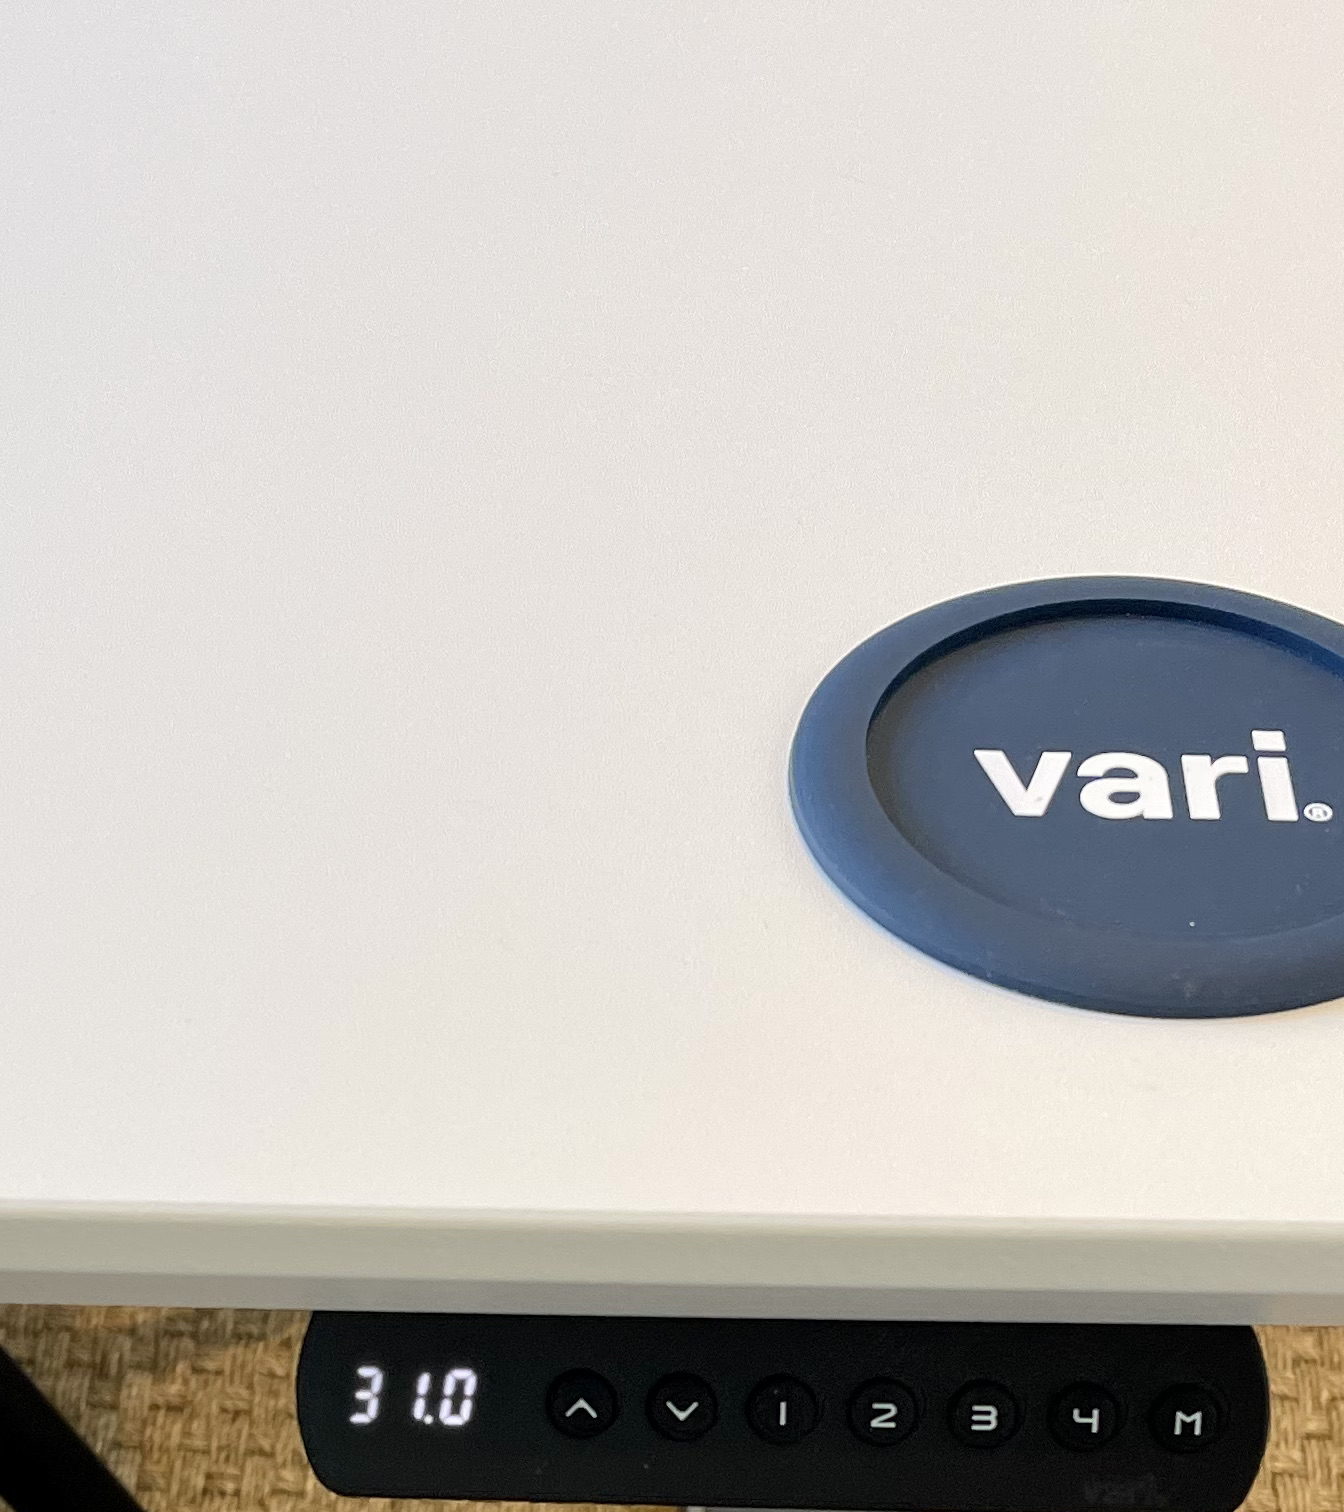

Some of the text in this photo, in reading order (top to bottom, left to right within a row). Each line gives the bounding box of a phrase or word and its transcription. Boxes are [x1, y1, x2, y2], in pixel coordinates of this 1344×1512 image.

[348, 1364, 479, 1427] 31.0
[778, 1400, 1204, 1437] 1 2 3 4 M
